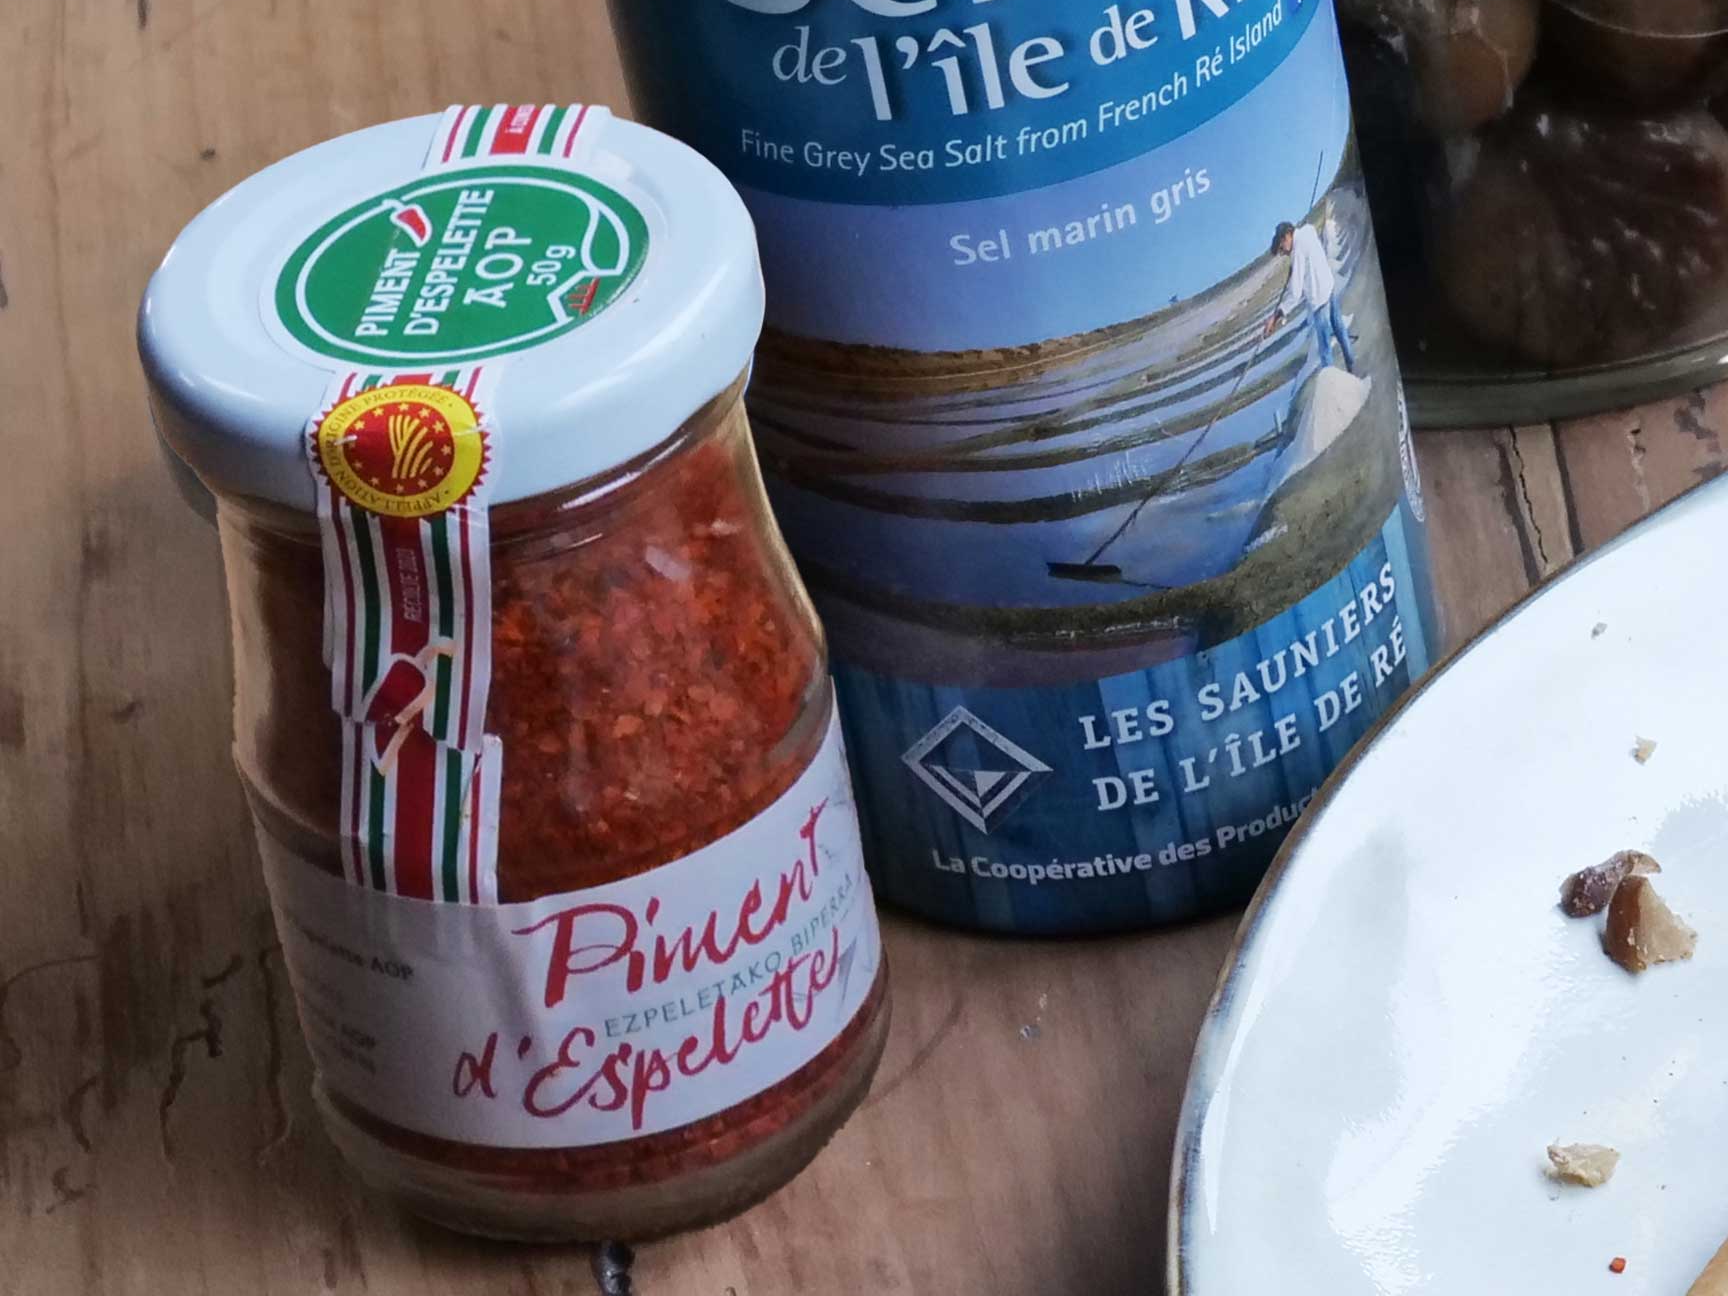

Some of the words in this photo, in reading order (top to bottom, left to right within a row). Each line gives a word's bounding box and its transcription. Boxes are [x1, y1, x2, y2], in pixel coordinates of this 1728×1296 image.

[740, 128, 796, 167] Fine
[803, 140, 871, 178] Grey
[878, 142, 935, 172] Sea
[944, 131, 1008, 170] Salt
[1015, 117, 1090, 157] from
[1096, 76, 1189, 135] French
[1194, 45, 1225, 91] Ré
[771, 25, 848, 86] de
[850, 21, 1071, 122] l'île
[1089, 4, 1158, 67] de
[403, 189, 495, 337] D'ESPELETTE
[463, 225, 534, 309] AOP
[526, 244, 578, 287] 50g
[949, 228, 1011, 267] Sel
[1027, 206, 1138, 255] marin
[1151, 164, 1212, 224] gris
[355, 247, 422, 338] PIMENT
[1078, 697, 1175, 750] LES
[1197, 560, 1398, 722] SAUNIERS
[1092, 768, 1160, 812] DE
[1178, 712, 1302, 793] L'ÎLE
[1313, 670, 1364, 732] DE
[1371, 613, 1409, 691] RÉ
[510, 796, 830, 1008] Piment
[932, 847, 966, 876] La
[970, 848, 1152, 886] Coopérative
[1161, 837, 1212, 866] des
[603, 951, 782, 1039] EZPELETAKO
